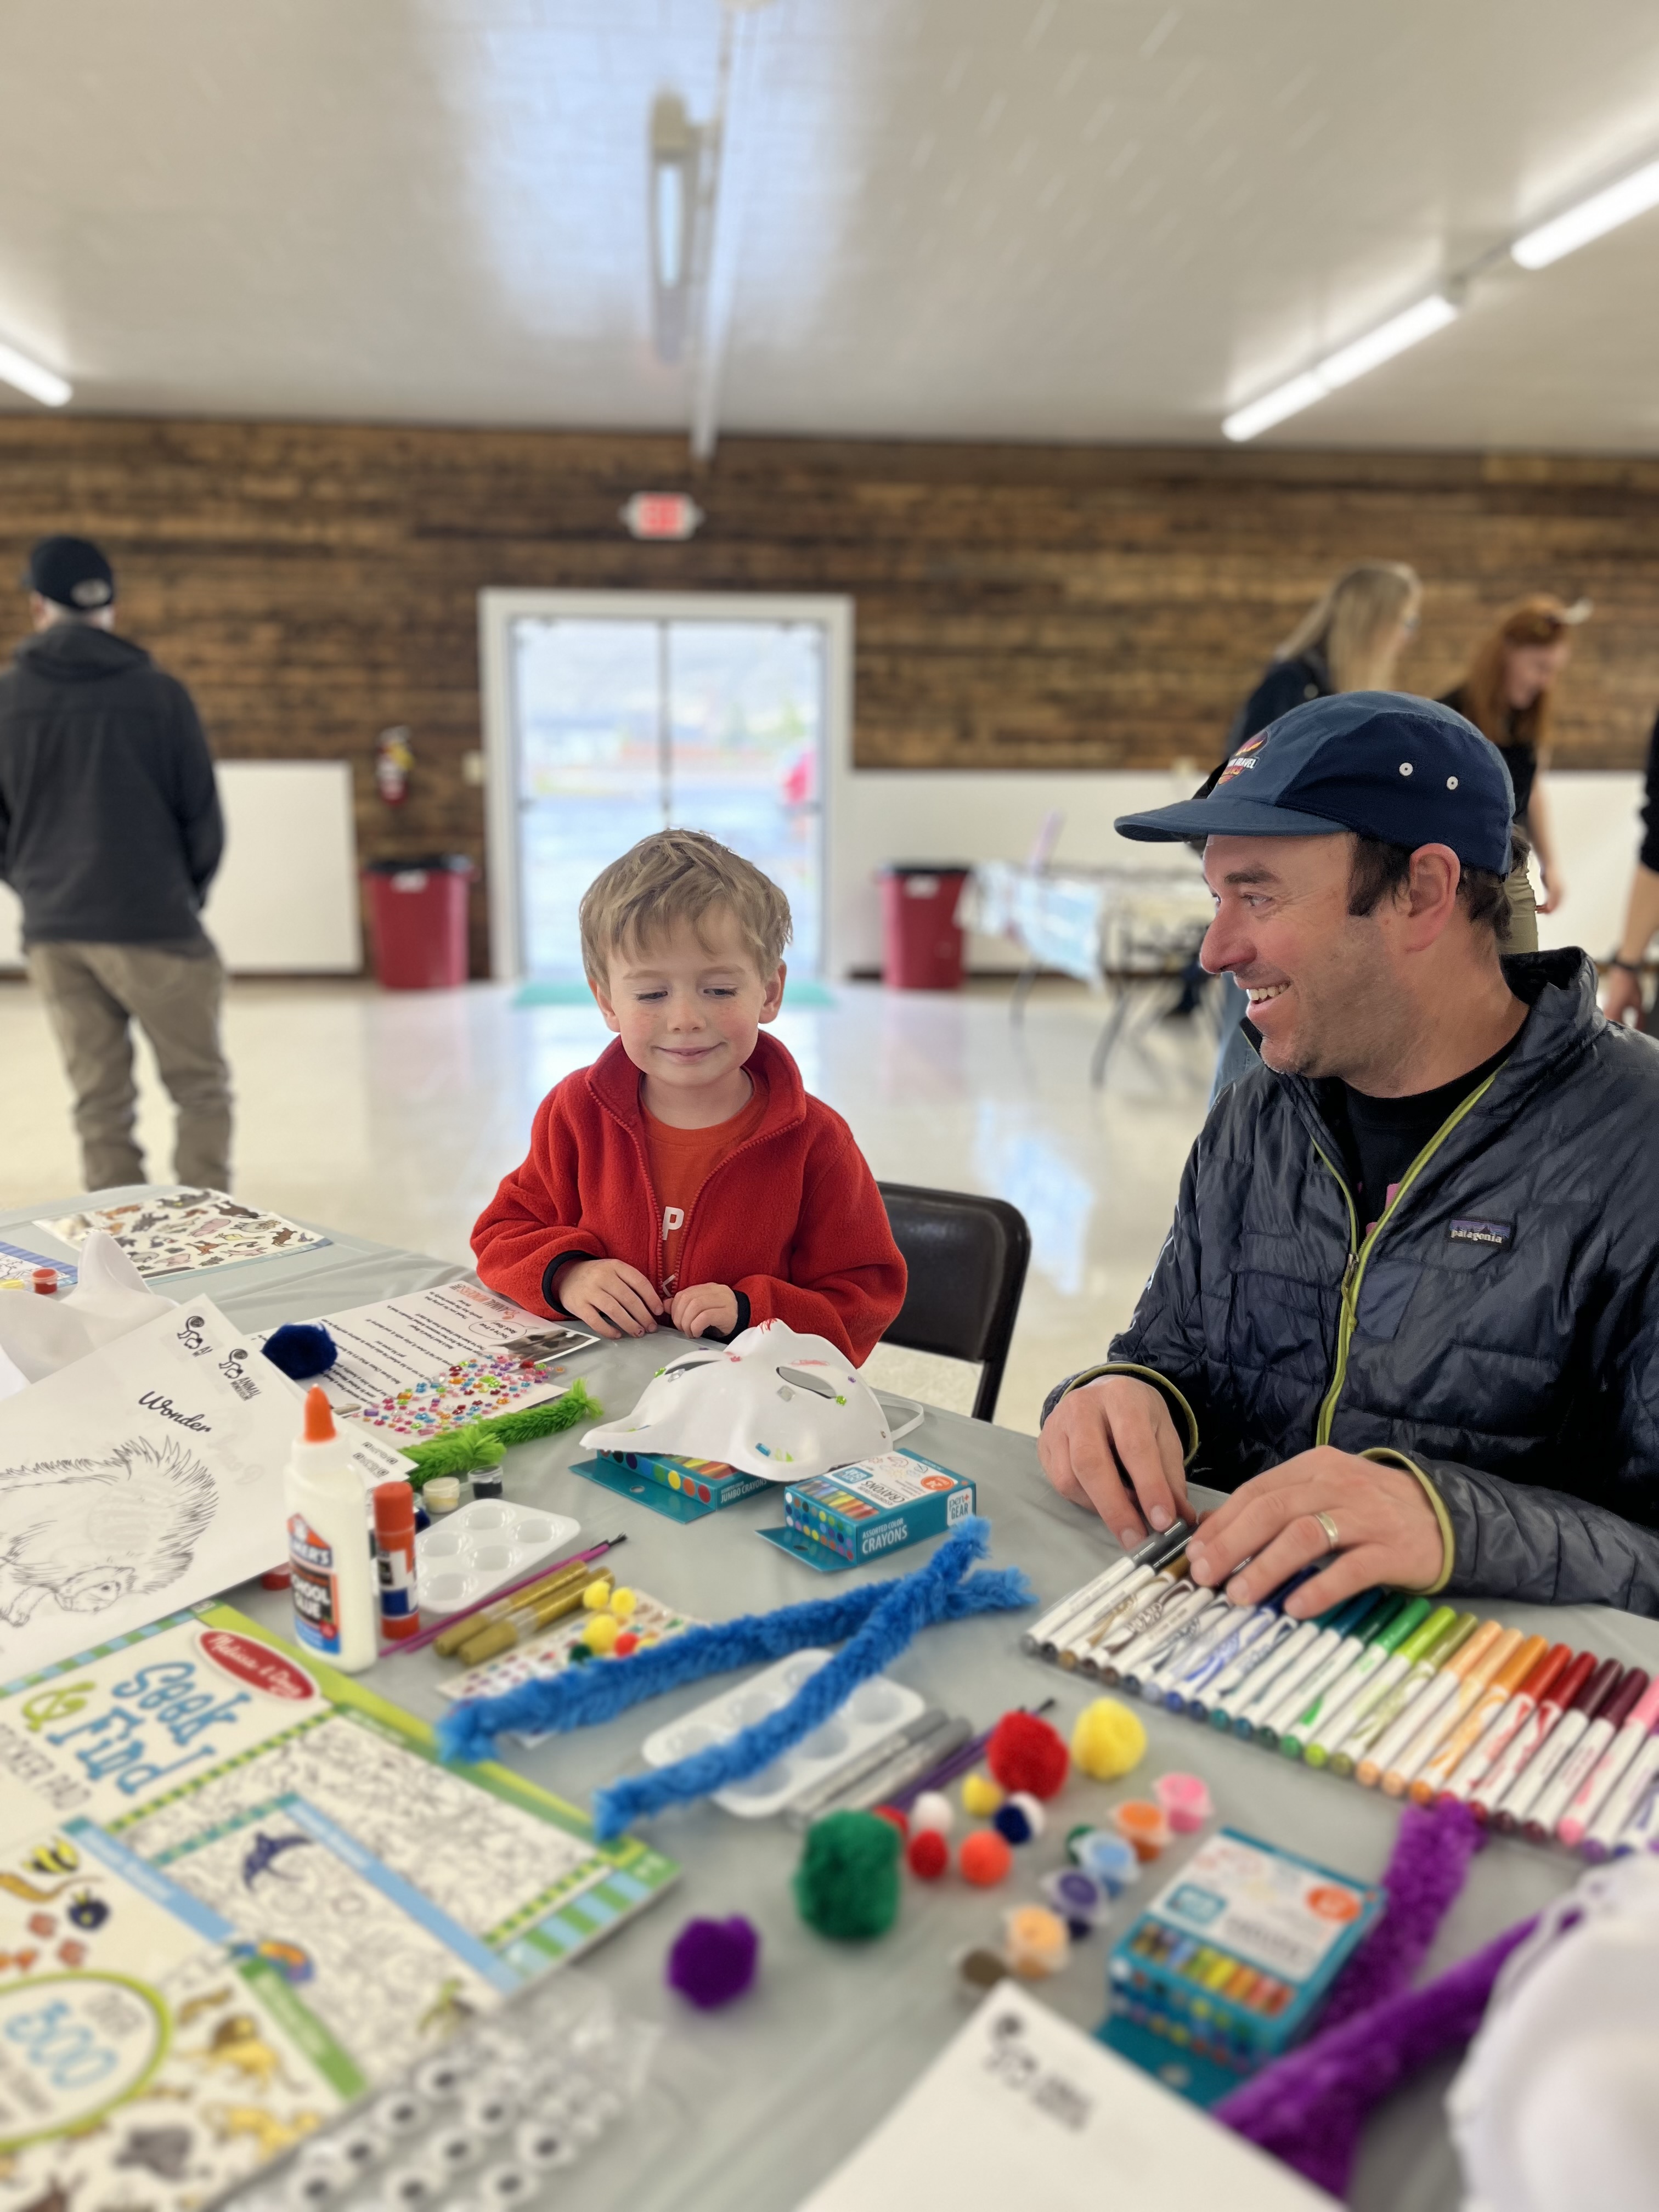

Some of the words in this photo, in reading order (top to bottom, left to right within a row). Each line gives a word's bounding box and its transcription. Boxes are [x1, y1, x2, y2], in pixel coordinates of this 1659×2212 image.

[1451, 1229, 1502, 1244] patagonia
[138, 1391, 212, 1432] Wonder
[721, 1487, 741, 1504] JUMBO
[742, 1478, 767, 1494] CRAYONS
[861, 1480, 905, 1503] CRAYONS
[951, 1503, 968, 1520] GEAR
[862, 1523, 887, 1539] ASSORTED
[888, 1517, 904, 1530] COLOR
[862, 1524, 907, 1555] CRAYONS
[111, 1661, 252, 1746] Seek
[45, 1705, 217, 1797] Find
